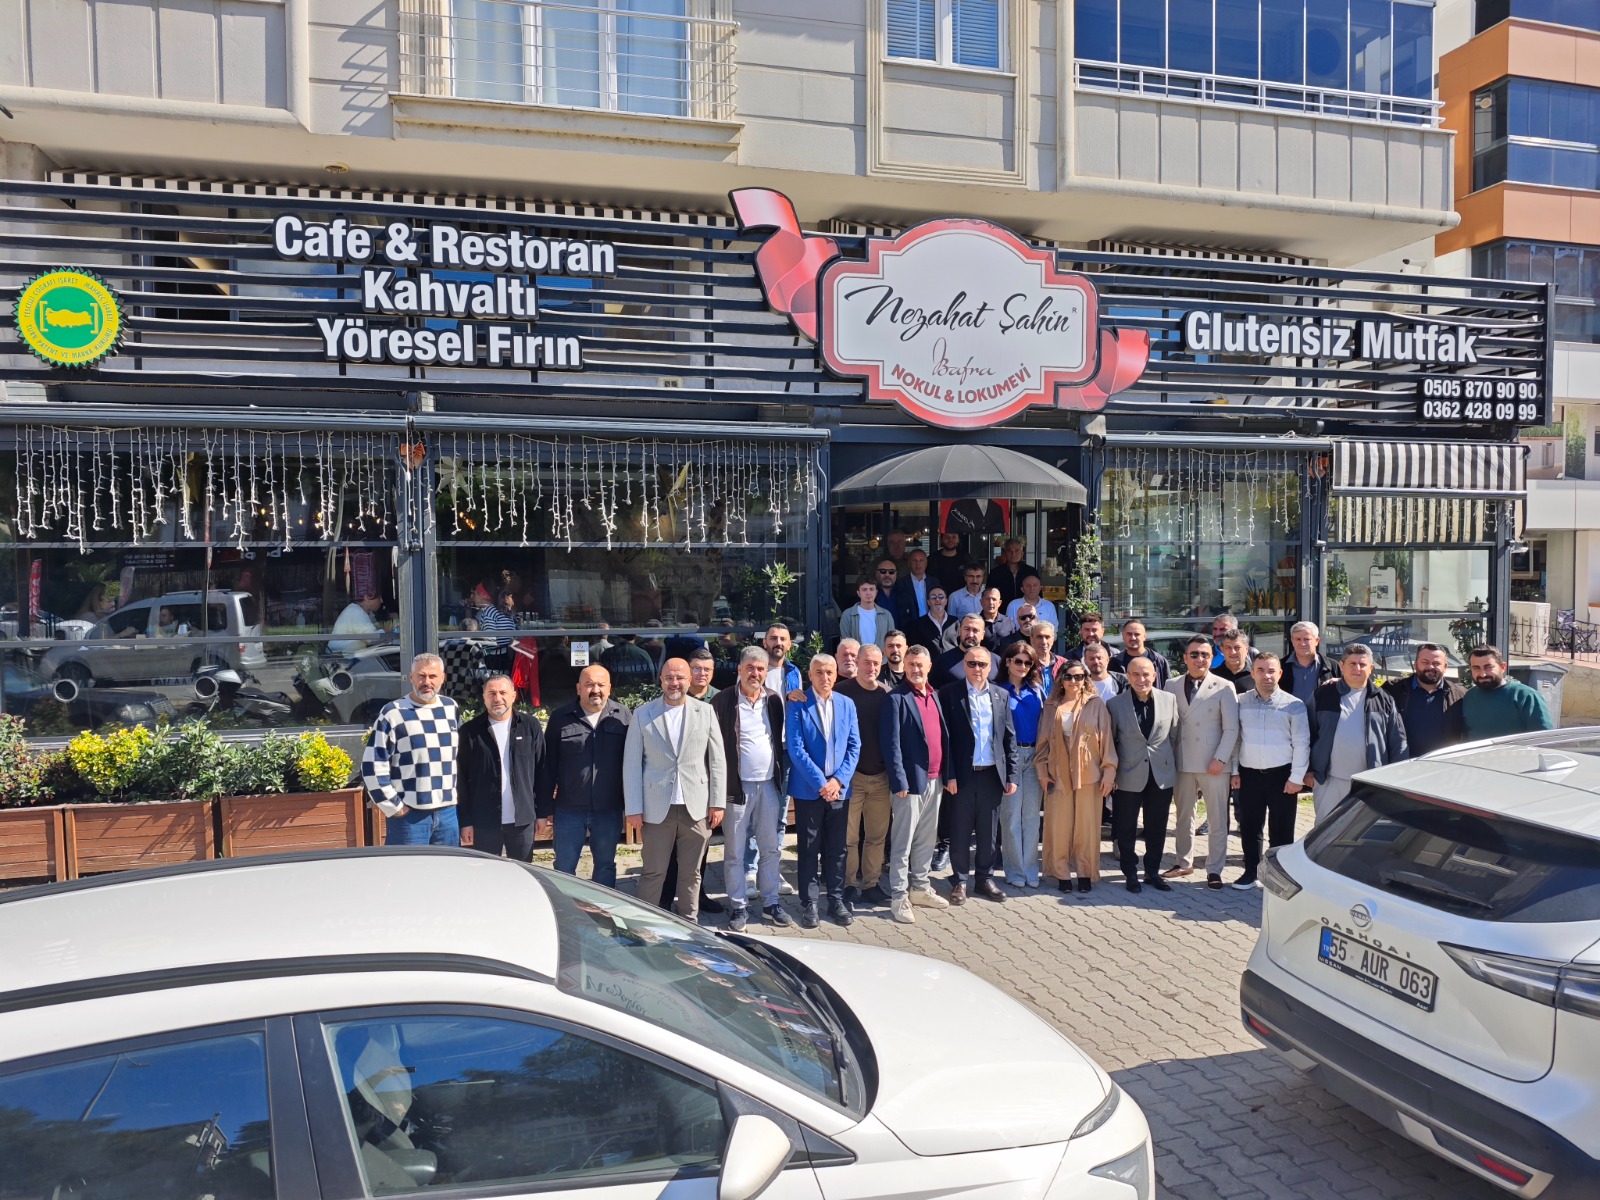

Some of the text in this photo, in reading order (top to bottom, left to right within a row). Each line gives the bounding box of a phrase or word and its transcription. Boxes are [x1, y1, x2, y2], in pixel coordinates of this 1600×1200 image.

[274, 215, 616, 273] Cafe & Restoran
[363, 270, 537, 316] Kahvaltı
[844, 284, 996, 342] Nezahat
[999, 293, 1070, 335] Şahin
[316, 317, 581, 367] Yöresel Fırın
[1187, 310, 1477, 363] Glutensiz Mutfak
[891, 362, 1032, 404] NOKUL & LOKUMEVİ
[932, 336, 997, 386] Bafra
[1423, 379, 1538, 400] 0505 870 90 90
[1423, 400, 1537, 421] 0362 428 09 99
[1321, 917, 1411, 959] QASHQAI
[1319, 956, 1342, 971] NISSAN
[1329, 935, 1348, 962] 55
[1361, 949, 1389, 982] AUR
[1400, 966, 1431, 999] 063
